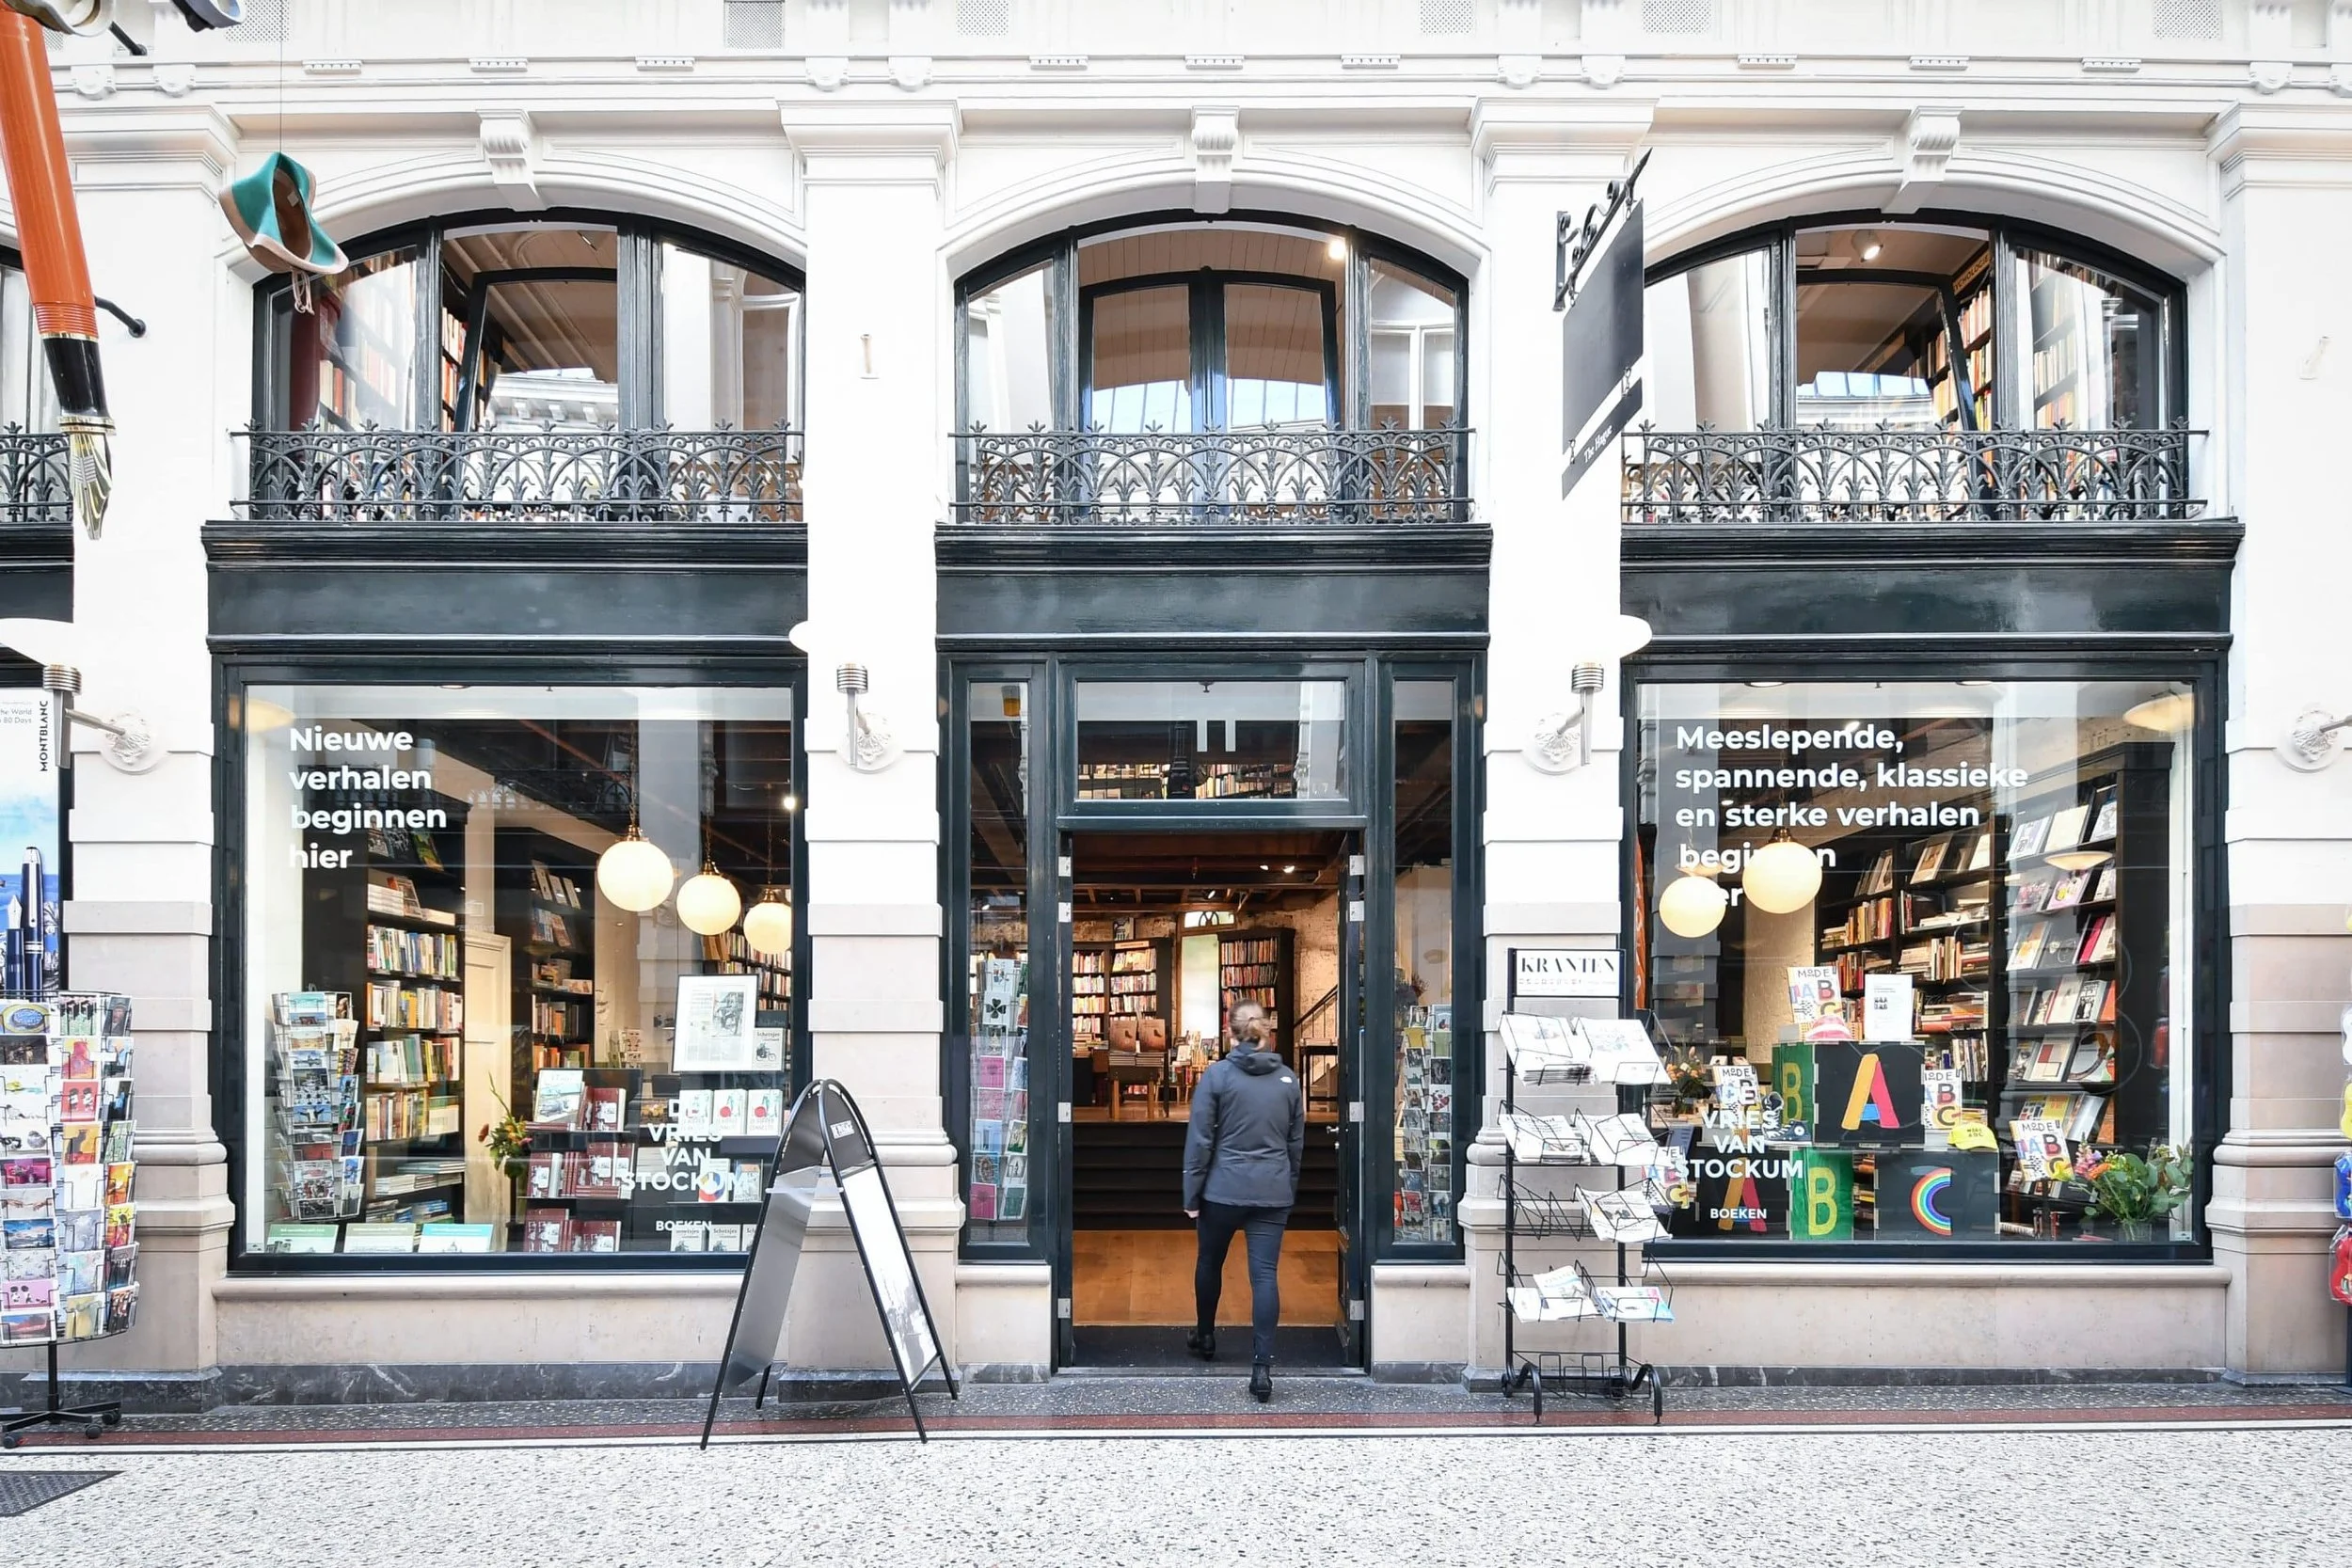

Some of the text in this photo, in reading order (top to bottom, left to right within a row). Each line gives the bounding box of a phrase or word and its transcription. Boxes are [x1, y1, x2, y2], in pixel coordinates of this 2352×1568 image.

[1583, 425, 1613, 463] The Hague
[40, 700, 48, 772] MONTBLANC
[290, 727, 413, 752] Nieuwe
[1677, 723, 1904, 755] Meeslepende,
[289, 765, 432, 790] verhalen
[1676, 761, 2028, 793] spannende, klassieke
[291, 805, 447, 834] beginnen
[1676, 801, 1980, 827] en sterke verhalen
[289, 845, 353, 868] hier
[1680, 842, 1836, 874] begin
[1521, 957, 1614, 973] KRANTEN
[1841, 1053, 1899, 1130] A
[659, 1148, 711, 1166] VAN
[1713, 1135, 1765, 1154] VAN
[1675, 1159, 1804, 1180] STOCKUM
[656, 1220, 712, 1231] BOEKEN
[1710, 1208, 1767, 1219] BOEKEN
